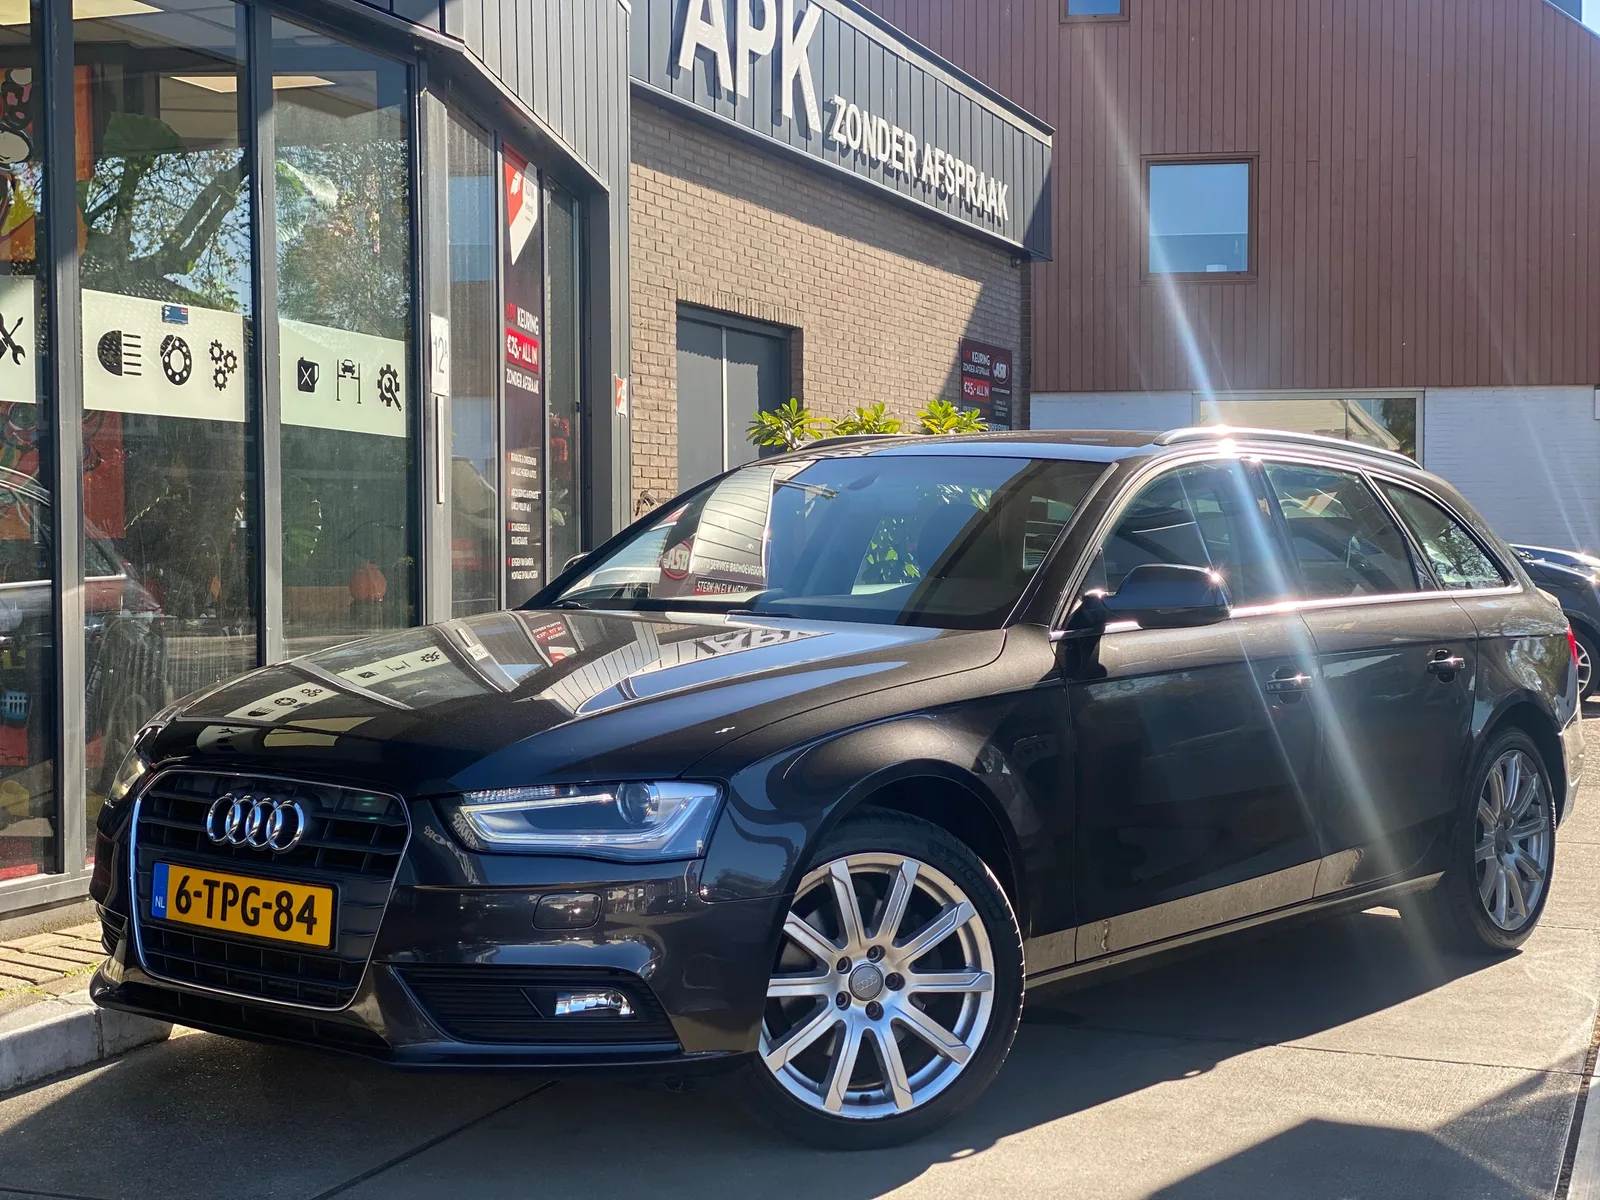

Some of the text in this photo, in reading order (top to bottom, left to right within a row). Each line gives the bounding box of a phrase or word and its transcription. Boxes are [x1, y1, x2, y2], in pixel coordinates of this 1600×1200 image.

[678, 0, 1009, 221] APK ZONDER AFSPRAAK
[522, 342, 531, 364] ALL
[531, 345, 538, 366] IN
[665, 549, 690, 571] ASB
[696, 580, 714, 592] STERK
[154, 895, 166, 909] NL
[174, 874, 318, 936] 6-TPG-84
